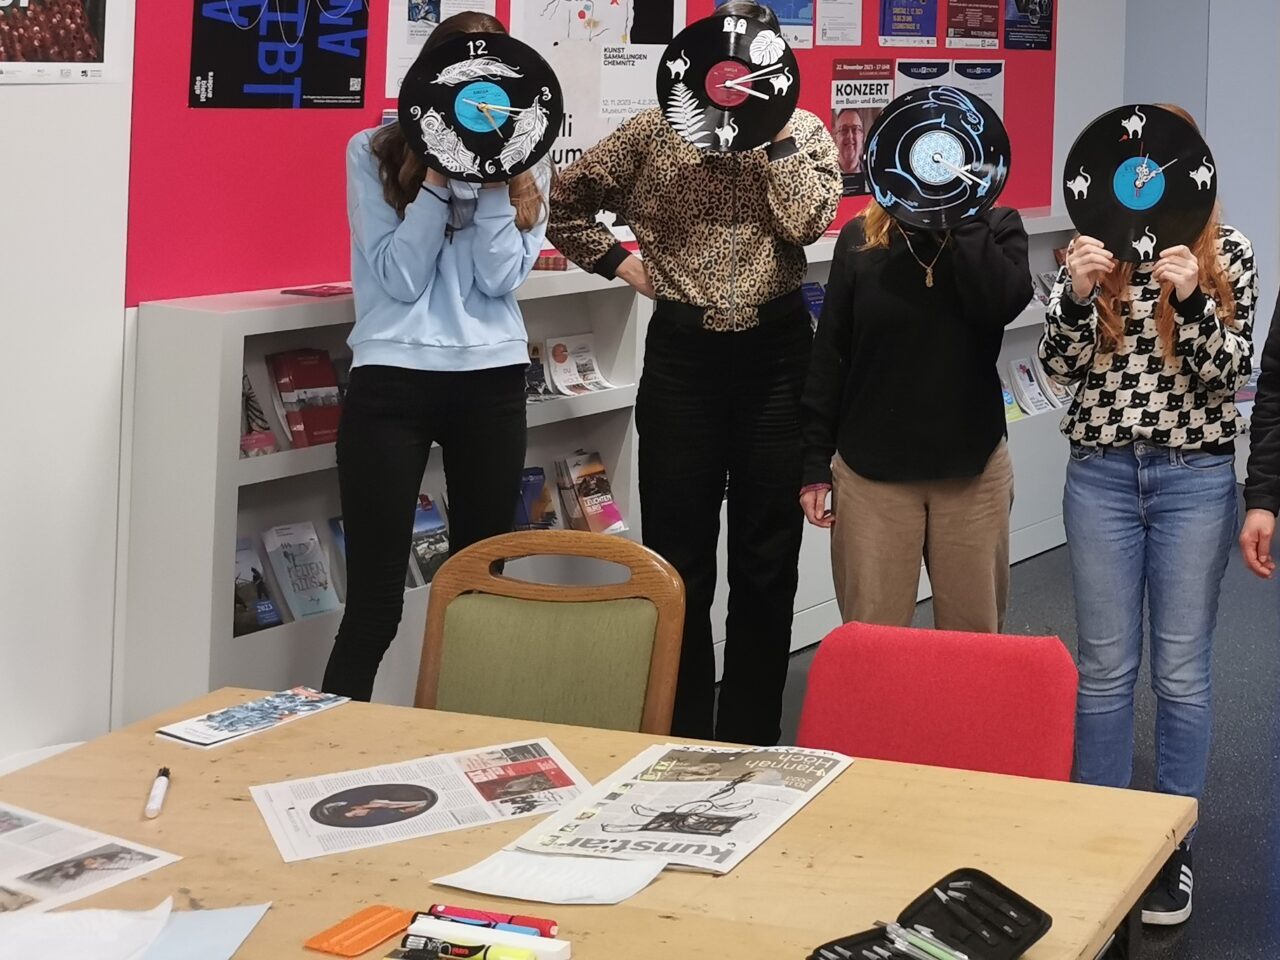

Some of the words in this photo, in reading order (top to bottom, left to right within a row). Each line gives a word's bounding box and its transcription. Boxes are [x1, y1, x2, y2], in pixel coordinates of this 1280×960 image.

[466, 40, 488, 56] 12
[541, 86, 552, 101] 3
[836, 83, 889, 96] KONZERT
[861, 97, 871, 105] und
[410, 105, 422, 121] 9
[602, 107, 627, 115] Museum
[485, 160, 496, 174] 6
[745, 760, 815, 774] Hannah
[778, 753, 833, 769] Höch
